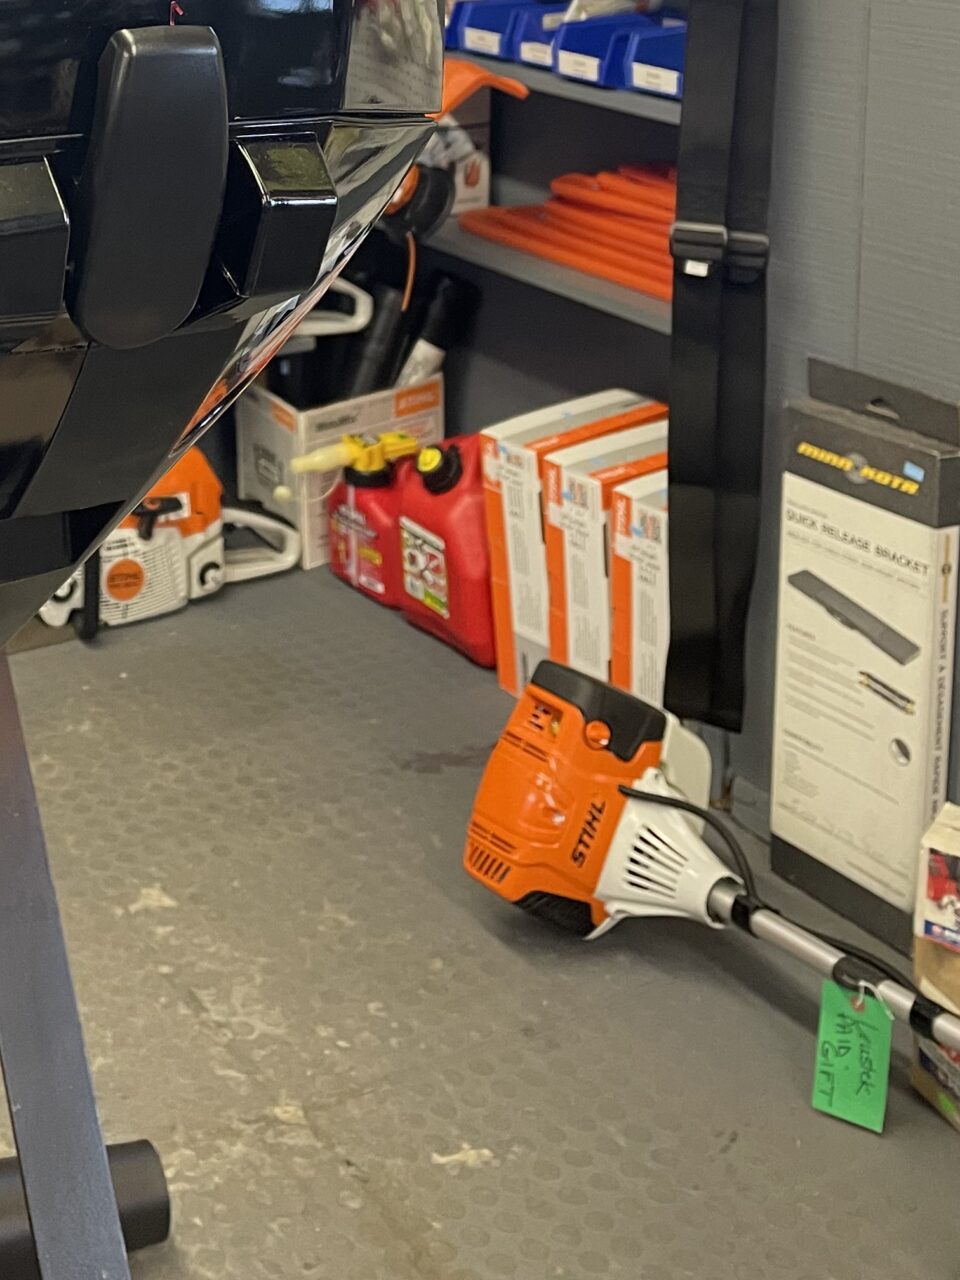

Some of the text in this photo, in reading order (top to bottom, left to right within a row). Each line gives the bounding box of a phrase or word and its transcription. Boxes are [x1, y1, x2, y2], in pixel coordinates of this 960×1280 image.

[822, 523, 872, 554] RELEASE
[875, 544, 929, 576] BRACKET
[571, 800, 606, 868] STIHL
[818, 1040, 836, 1107] GIFT
